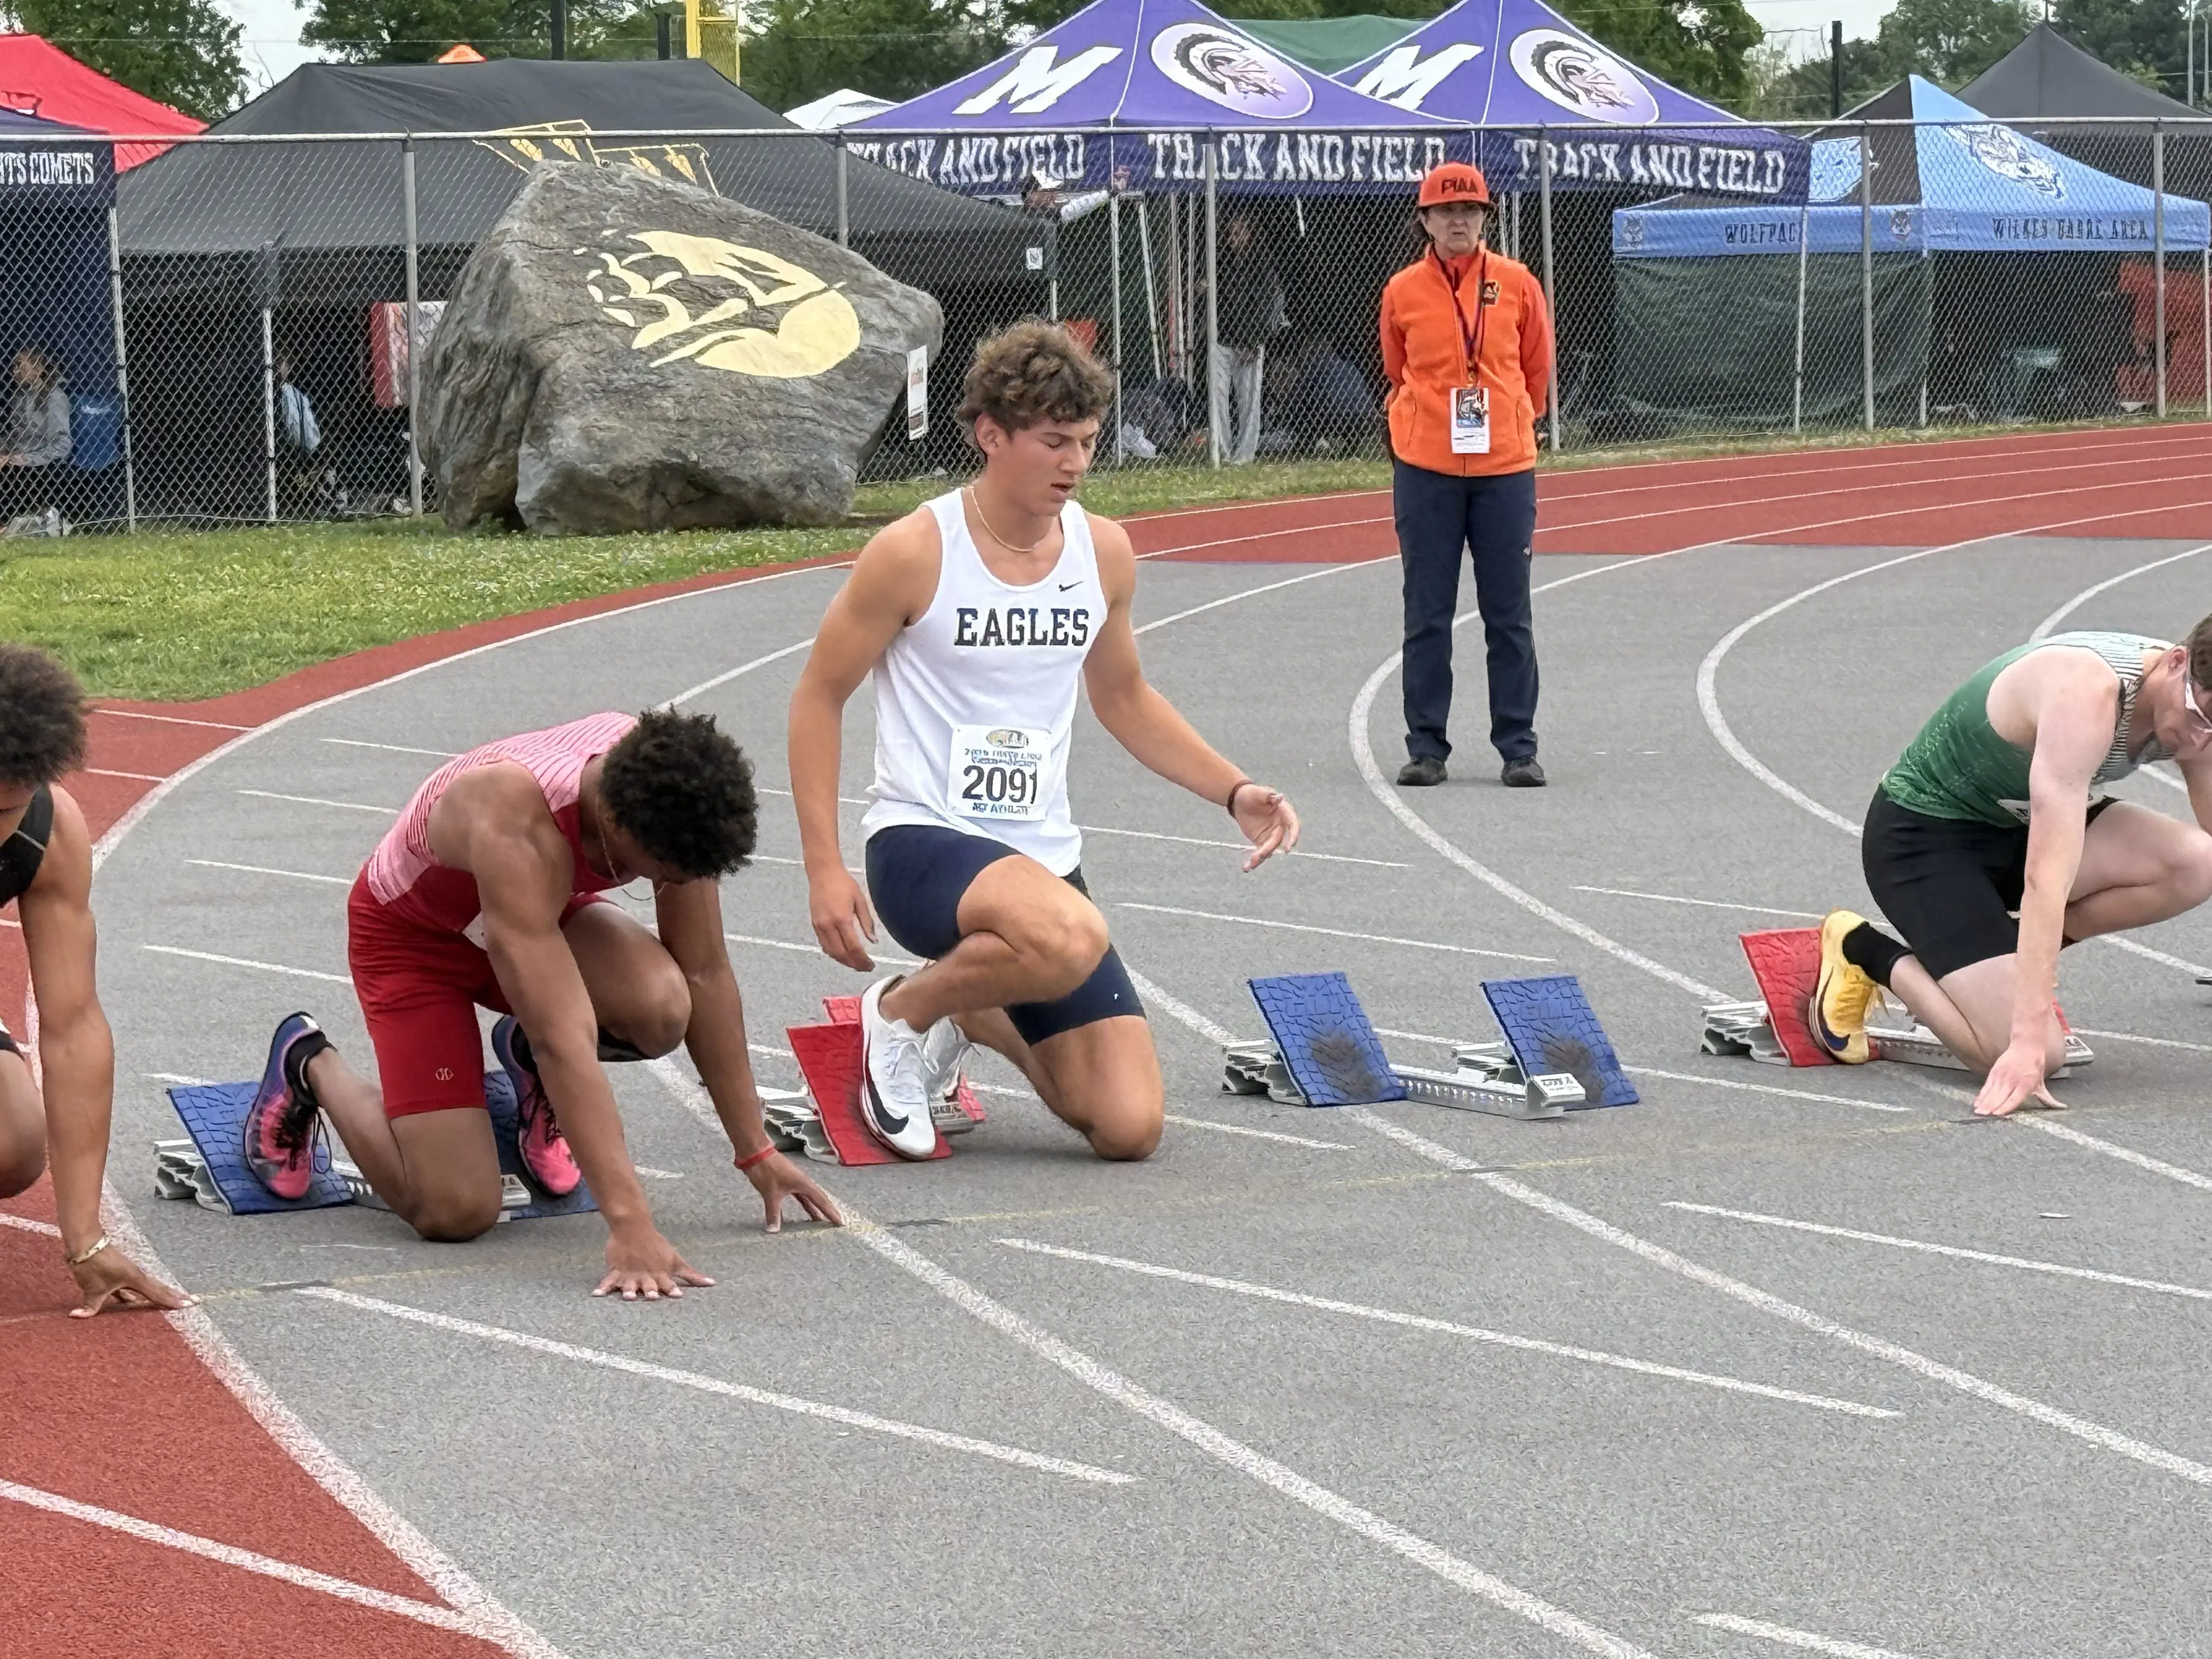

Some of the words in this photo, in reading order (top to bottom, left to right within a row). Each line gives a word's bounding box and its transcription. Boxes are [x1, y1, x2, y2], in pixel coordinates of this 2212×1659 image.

[951, 45, 1124, 114] M
[30, 152, 94, 184] COMETS
[940, 137, 999, 184] AND
[1003, 134, 1085, 182] FIELD
[1273, 133, 1344, 182] AND
[1351, 136, 1445, 182] FIELD
[1630, 144, 1694, 188] AND
[1699, 146, 1786, 193] FIELD
[1724, 222, 1802, 244] WOLFPAC
[954, 608, 1090, 646] EAGLES
[962, 765, 1037, 804] 2091
